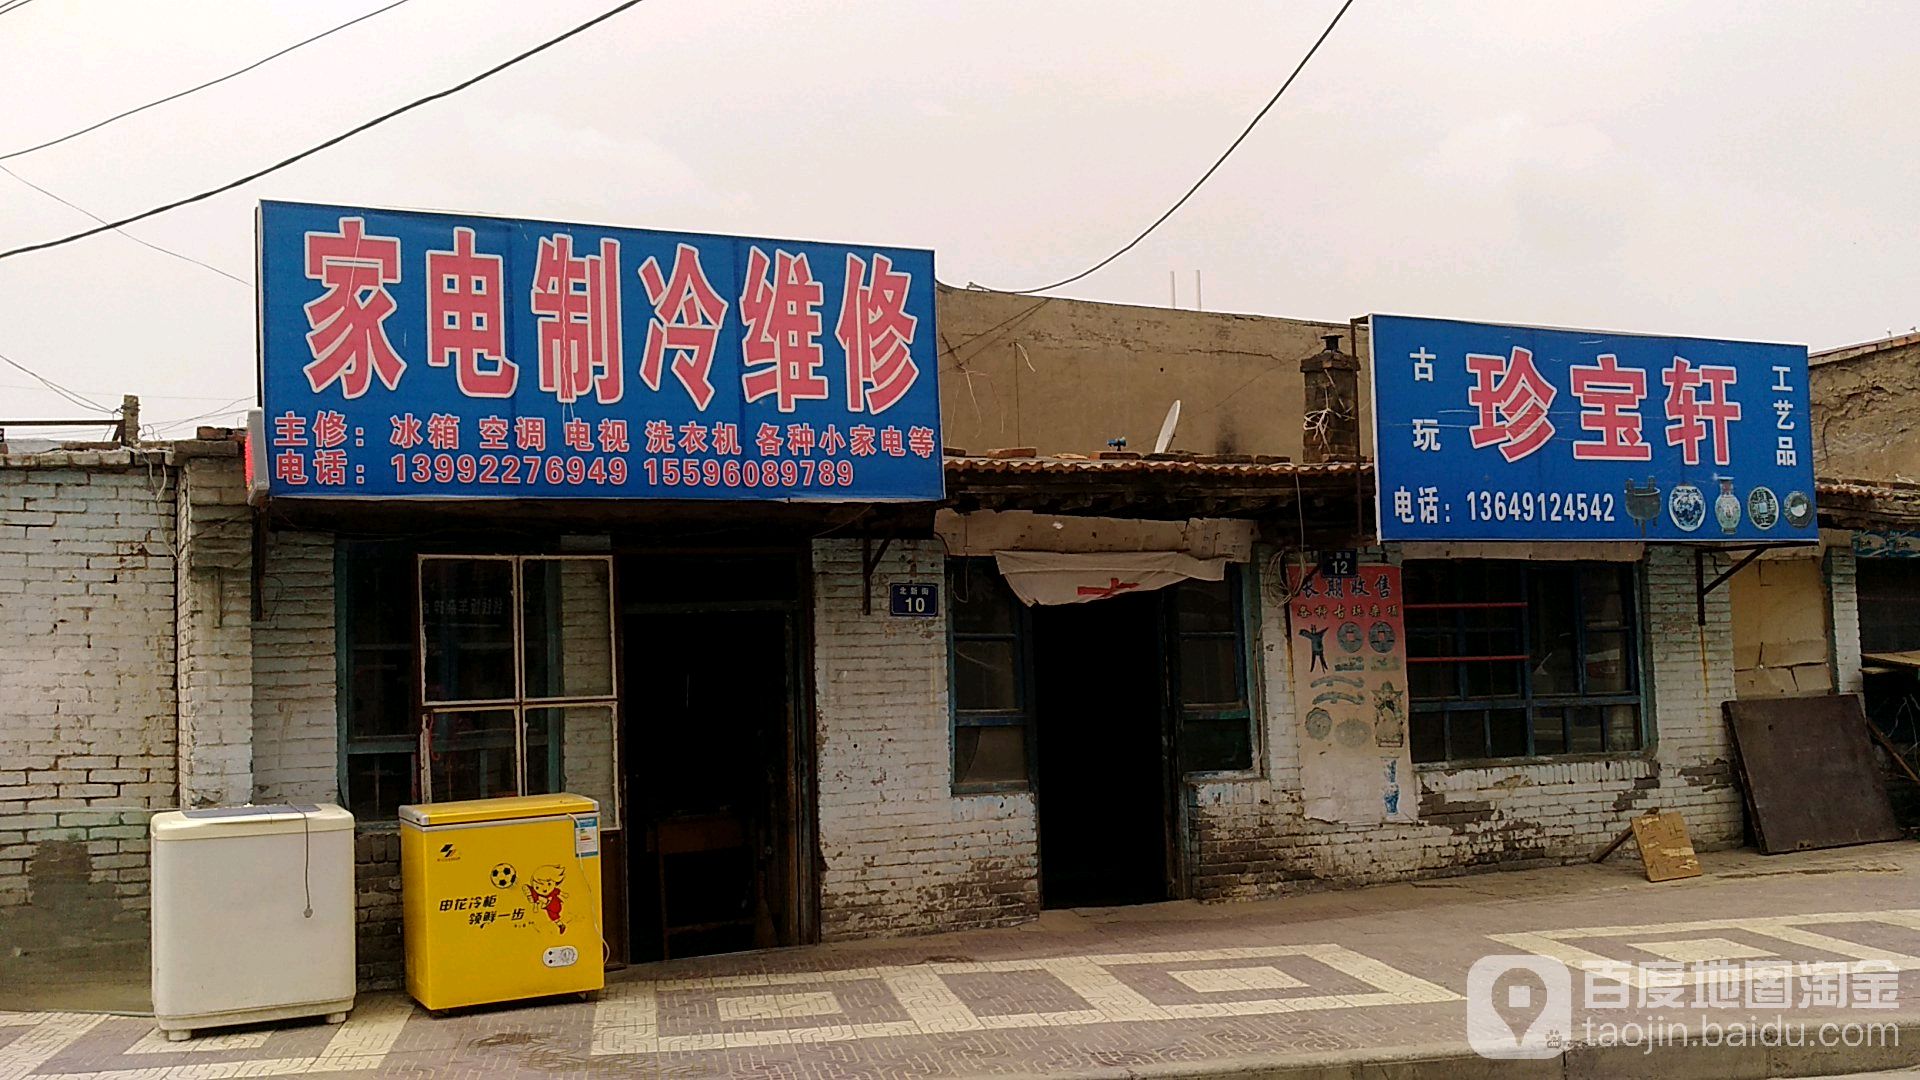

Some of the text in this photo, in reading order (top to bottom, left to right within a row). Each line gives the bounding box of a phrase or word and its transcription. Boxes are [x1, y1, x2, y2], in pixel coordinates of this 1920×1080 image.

[303, 217, 919, 414] 家电制冷维修
[1409, 347, 1441, 452] 古玩
[1466, 346, 1741, 466] 珍宝轩
[1772, 365, 1796, 467] 工艺品
[390, 413, 460, 450] 冰箱
[479, 416, 546, 452] 空调
[564, 418, 629, 454] 电视
[645, 419, 741, 456] 洗衣机
[756, 422, 936, 460] 各种小家电等
[392, 453, 628, 485] 13992276949
[643, 458, 854, 487] 15596089789
[1467, 490, 1615, 523] 13649124542
[1331, 560, 1348, 574] 12
[905, 597, 925, 612] 10
[439, 894, 497, 912] 申花冷柜
[468, 908, 525, 927] 领鲜一步
